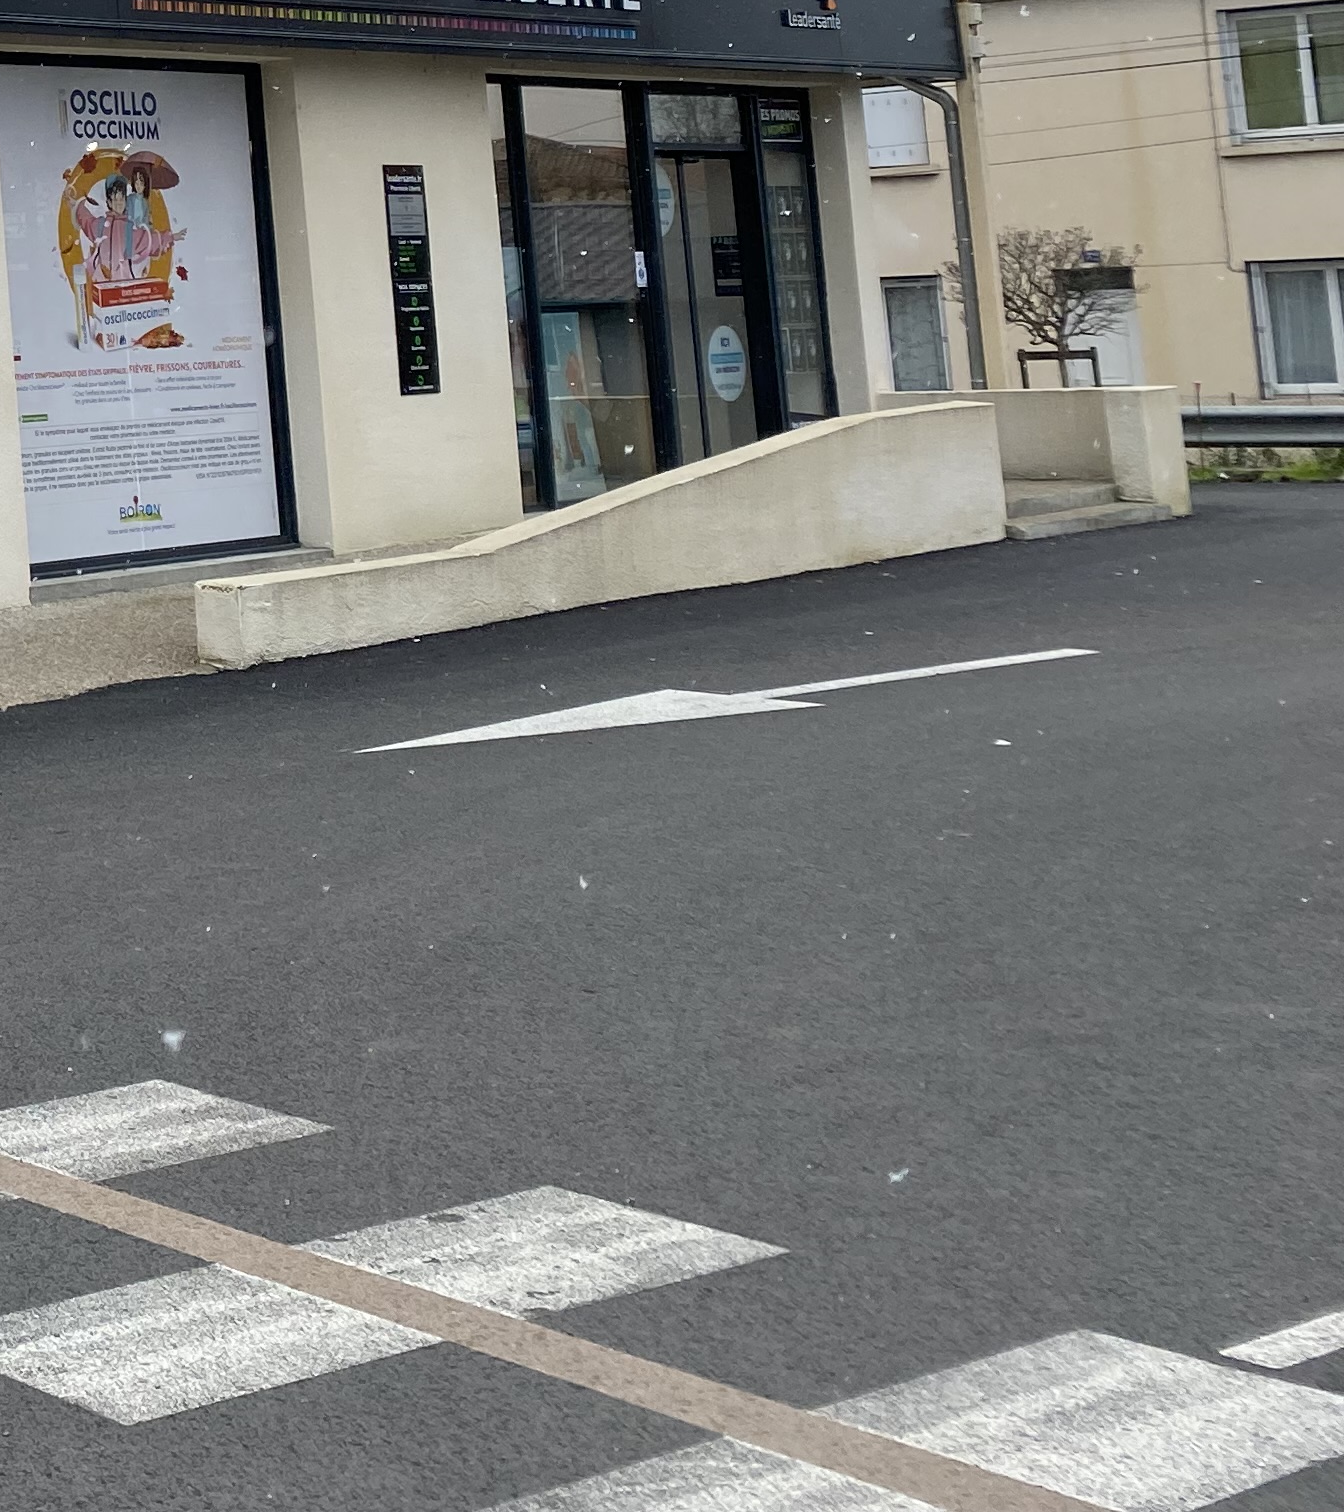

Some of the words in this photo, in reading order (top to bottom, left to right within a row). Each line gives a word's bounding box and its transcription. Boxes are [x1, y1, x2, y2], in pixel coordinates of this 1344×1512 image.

[69, 88, 157, 117] OSCILLO
[72, 119, 160, 141] COCCINUM
[119, 496, 162, 521] BOIRON
